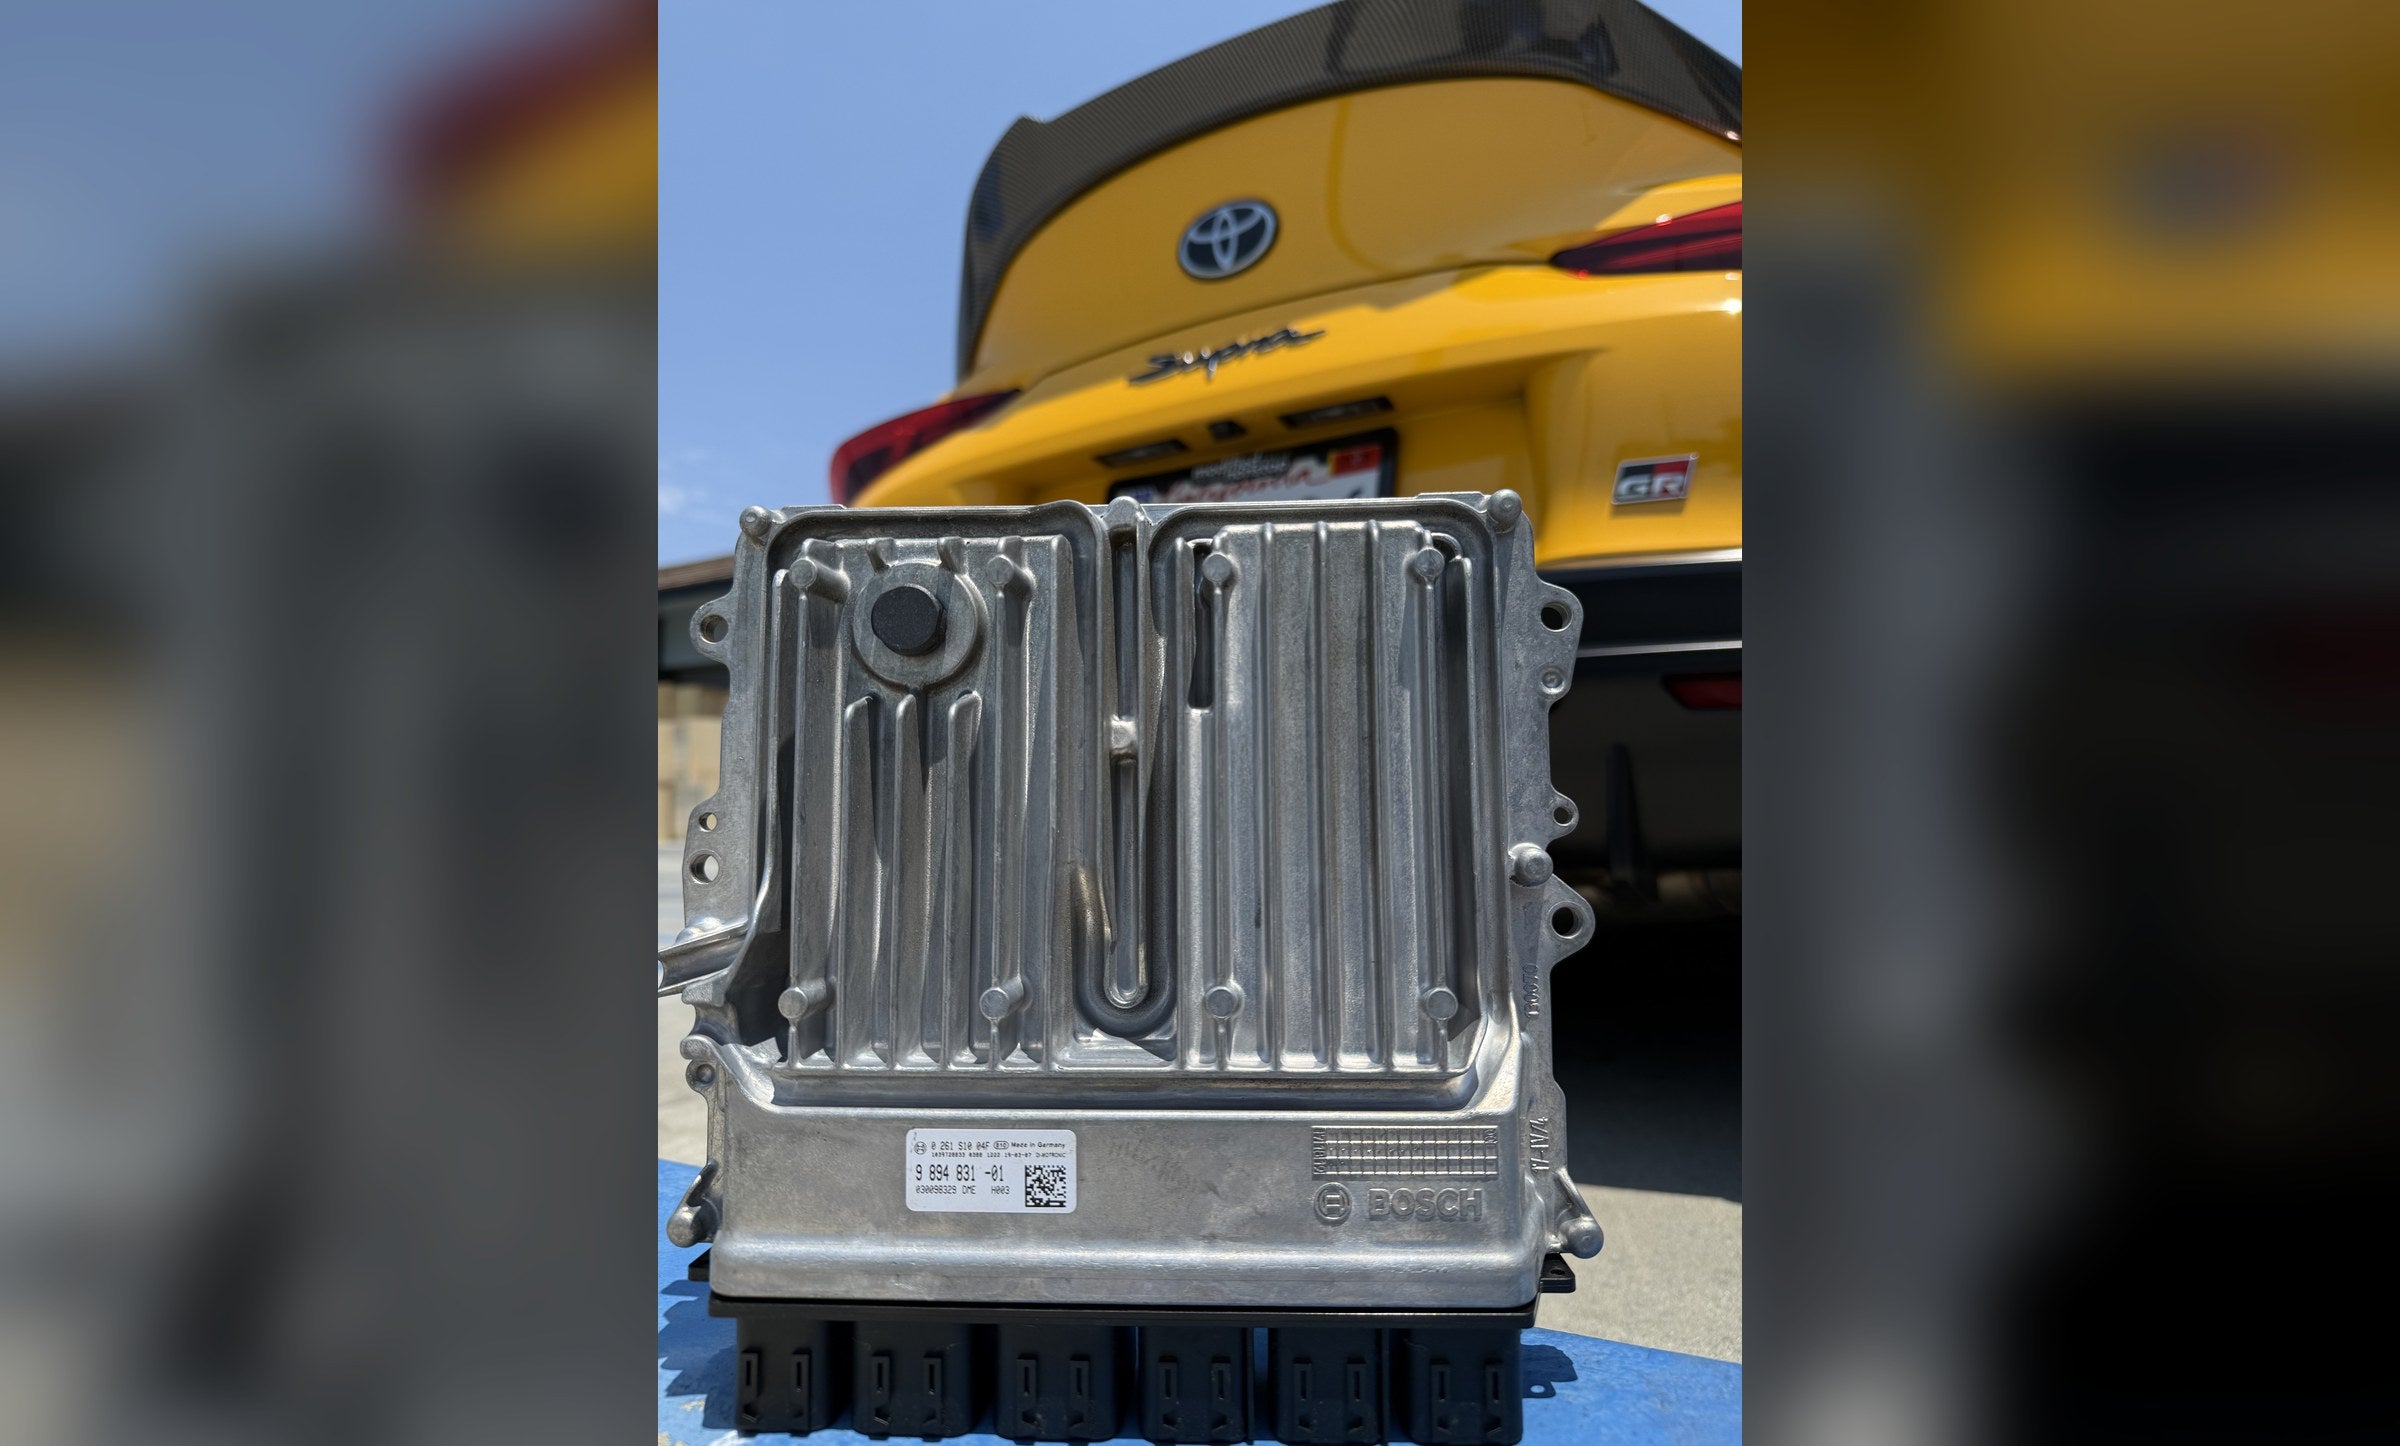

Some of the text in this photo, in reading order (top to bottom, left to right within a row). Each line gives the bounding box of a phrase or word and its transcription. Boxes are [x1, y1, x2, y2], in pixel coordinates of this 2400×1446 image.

[1616, 472, 1686, 500] GR
[940, 1141, 954, 1151] 261
[1037, 1141, 1066, 1149] Germany
[915, 1163, 1004, 1182] 9 894 831 -01
[962, 1185, 976, 1195] DME
[1368, 1188, 1483, 1221] BOSCH
